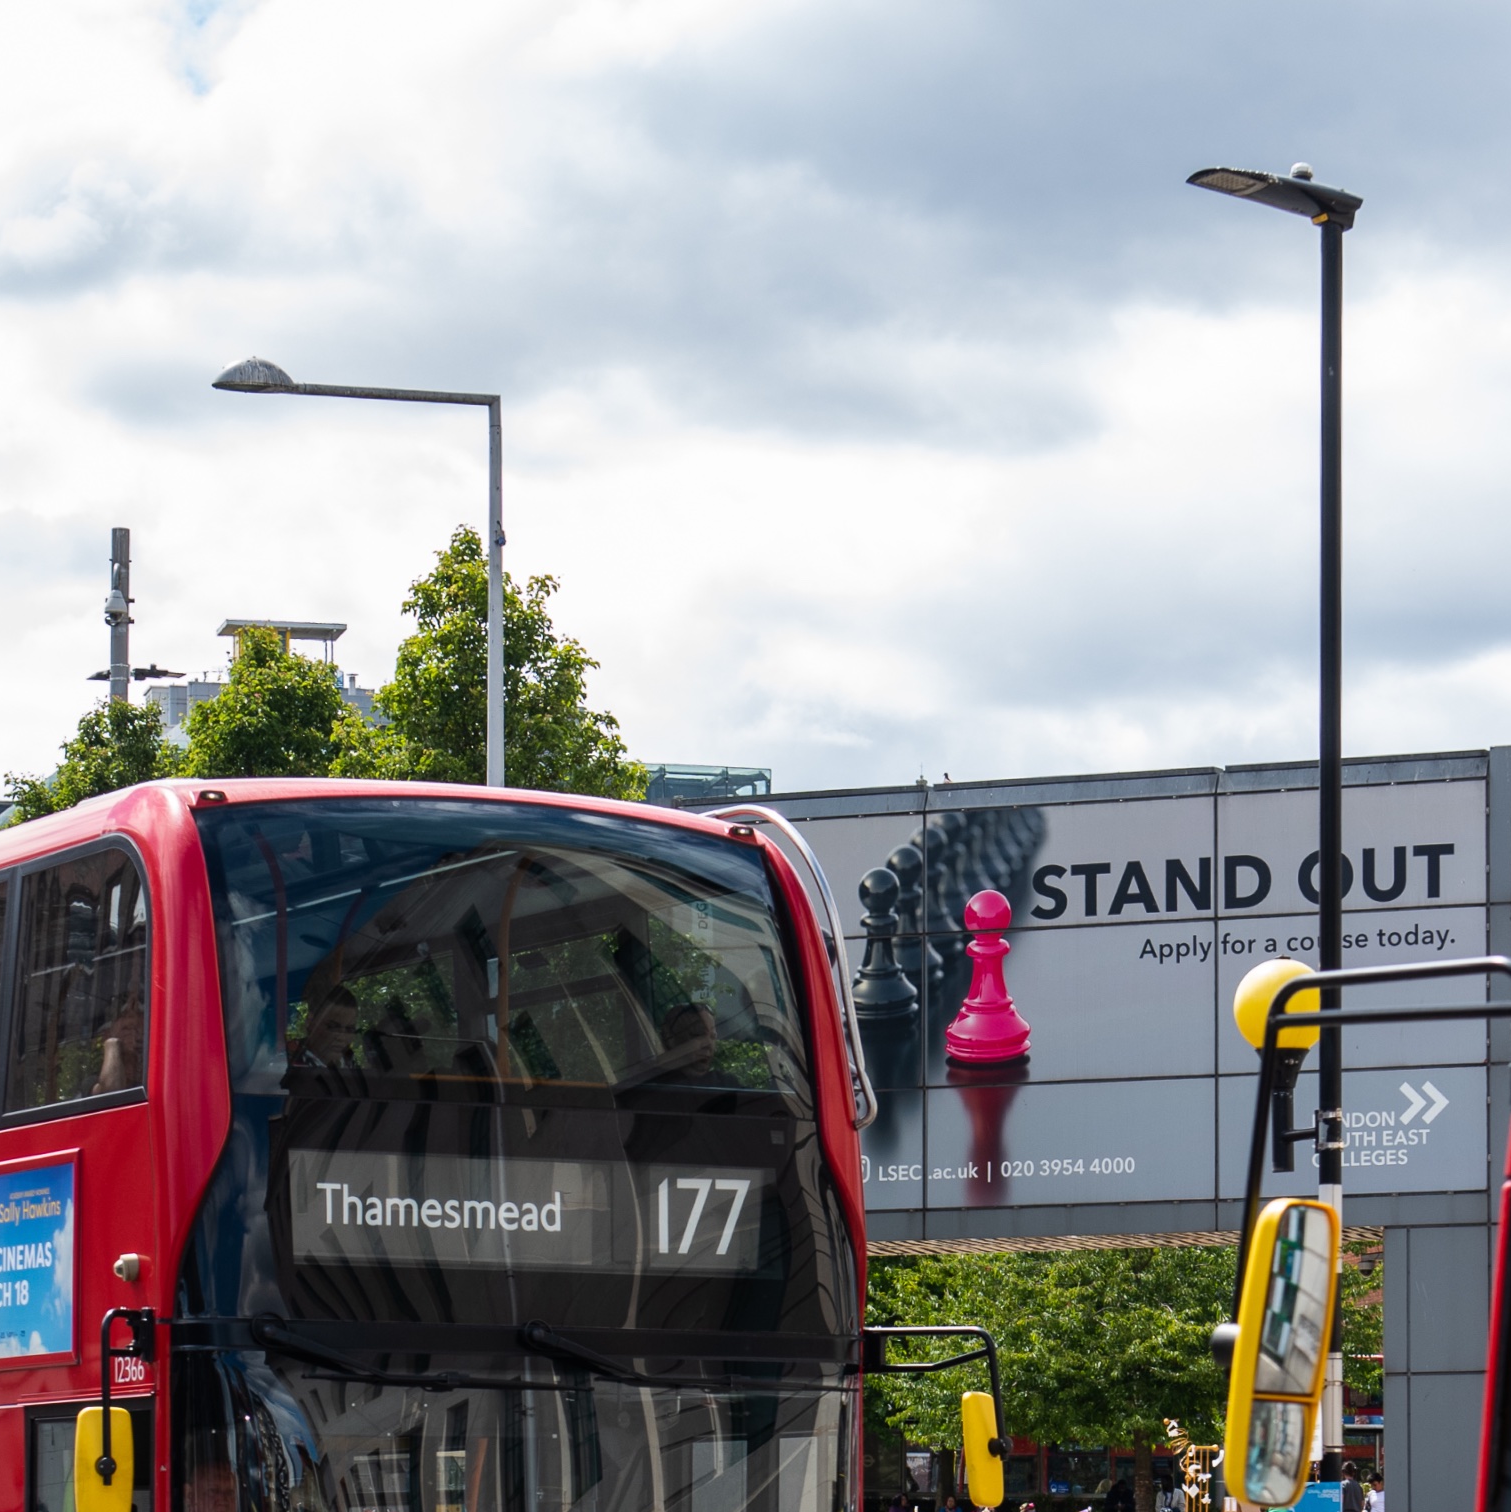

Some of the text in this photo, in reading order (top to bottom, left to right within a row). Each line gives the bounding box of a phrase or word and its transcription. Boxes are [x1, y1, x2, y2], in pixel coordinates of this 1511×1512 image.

[1030, 843, 1455, 920] STAND OUT
[1139, 925, 1457, 965] Apply for a cose today.
[1312, 1111, 1395, 1130] NDON
[1382, 1129, 1430, 1146] EAST
[1000, 1160, 1035, 1178] 020
[1039, 1158, 1085, 1177] 3954
[1089, 1157, 1136, 1175] 4000
[22, 1196, 61, 1220] Hawkins
[316, 1176, 751, 1255] Thamesmead 177
[15, 1280, 30, 1306] 18
[115, 1356, 145, 1383] 12366
